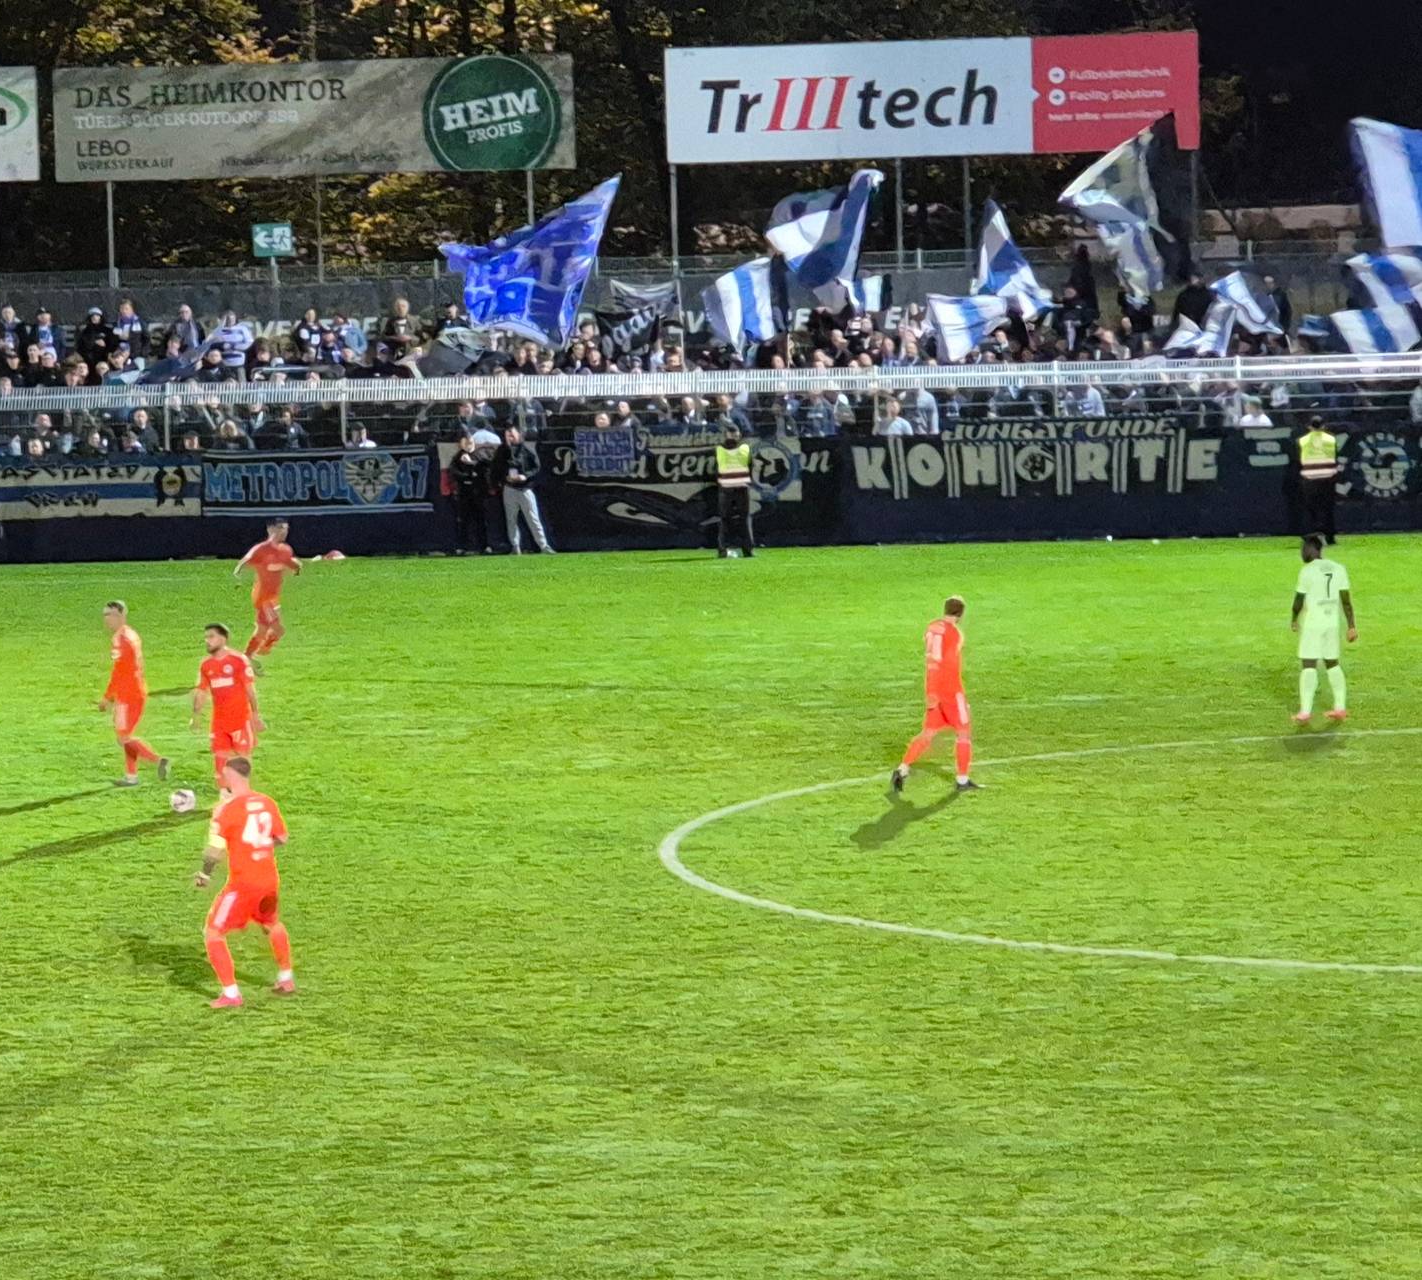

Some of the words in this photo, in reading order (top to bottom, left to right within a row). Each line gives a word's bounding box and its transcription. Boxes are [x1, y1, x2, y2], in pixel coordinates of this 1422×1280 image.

[439, 87, 540, 132] HEIM
[466, 120, 523, 144] PROFIS
[76, 139, 130, 157] LEBO
[1323, 572, 1333, 599] 7
[241, 811, 273, 848] 42
